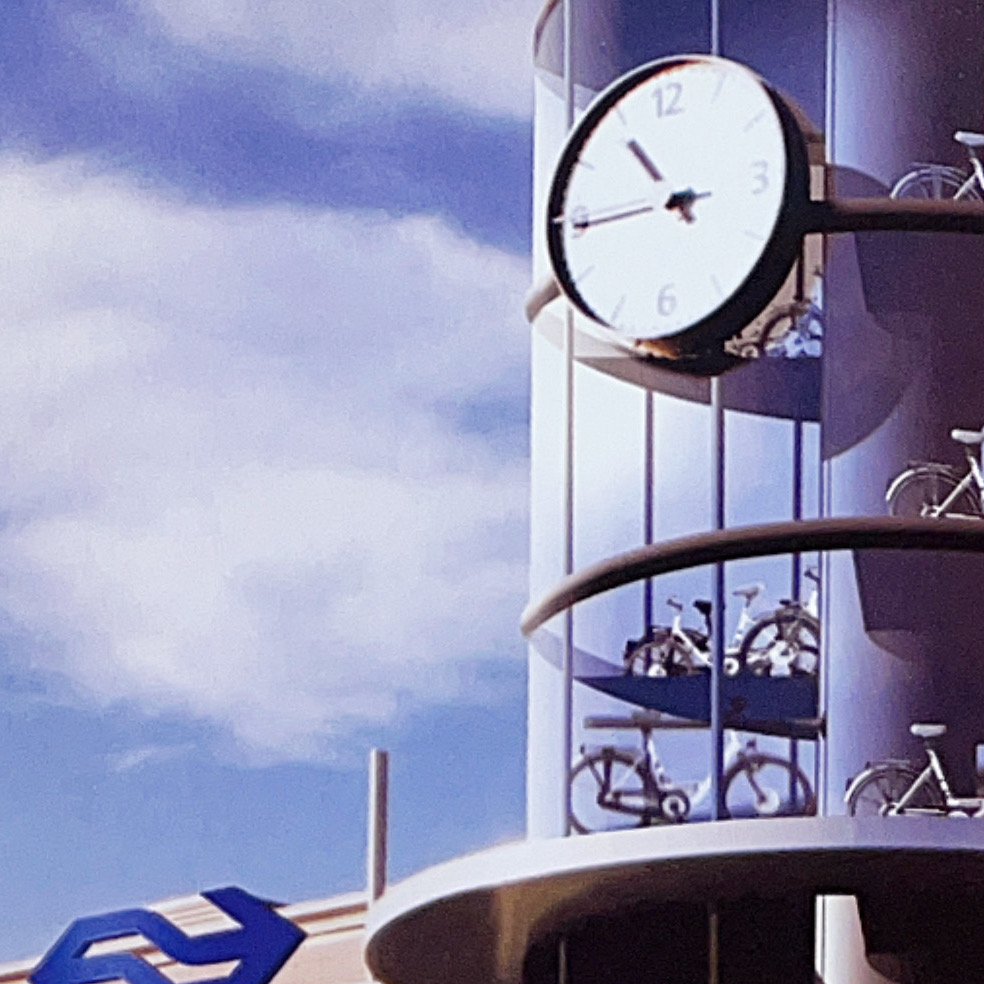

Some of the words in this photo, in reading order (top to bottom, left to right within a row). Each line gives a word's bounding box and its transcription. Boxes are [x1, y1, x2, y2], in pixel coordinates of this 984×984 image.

[651, 82, 685, 118] 12
[751, 160, 770, 196] 3
[657, 283, 678, 317] 6
